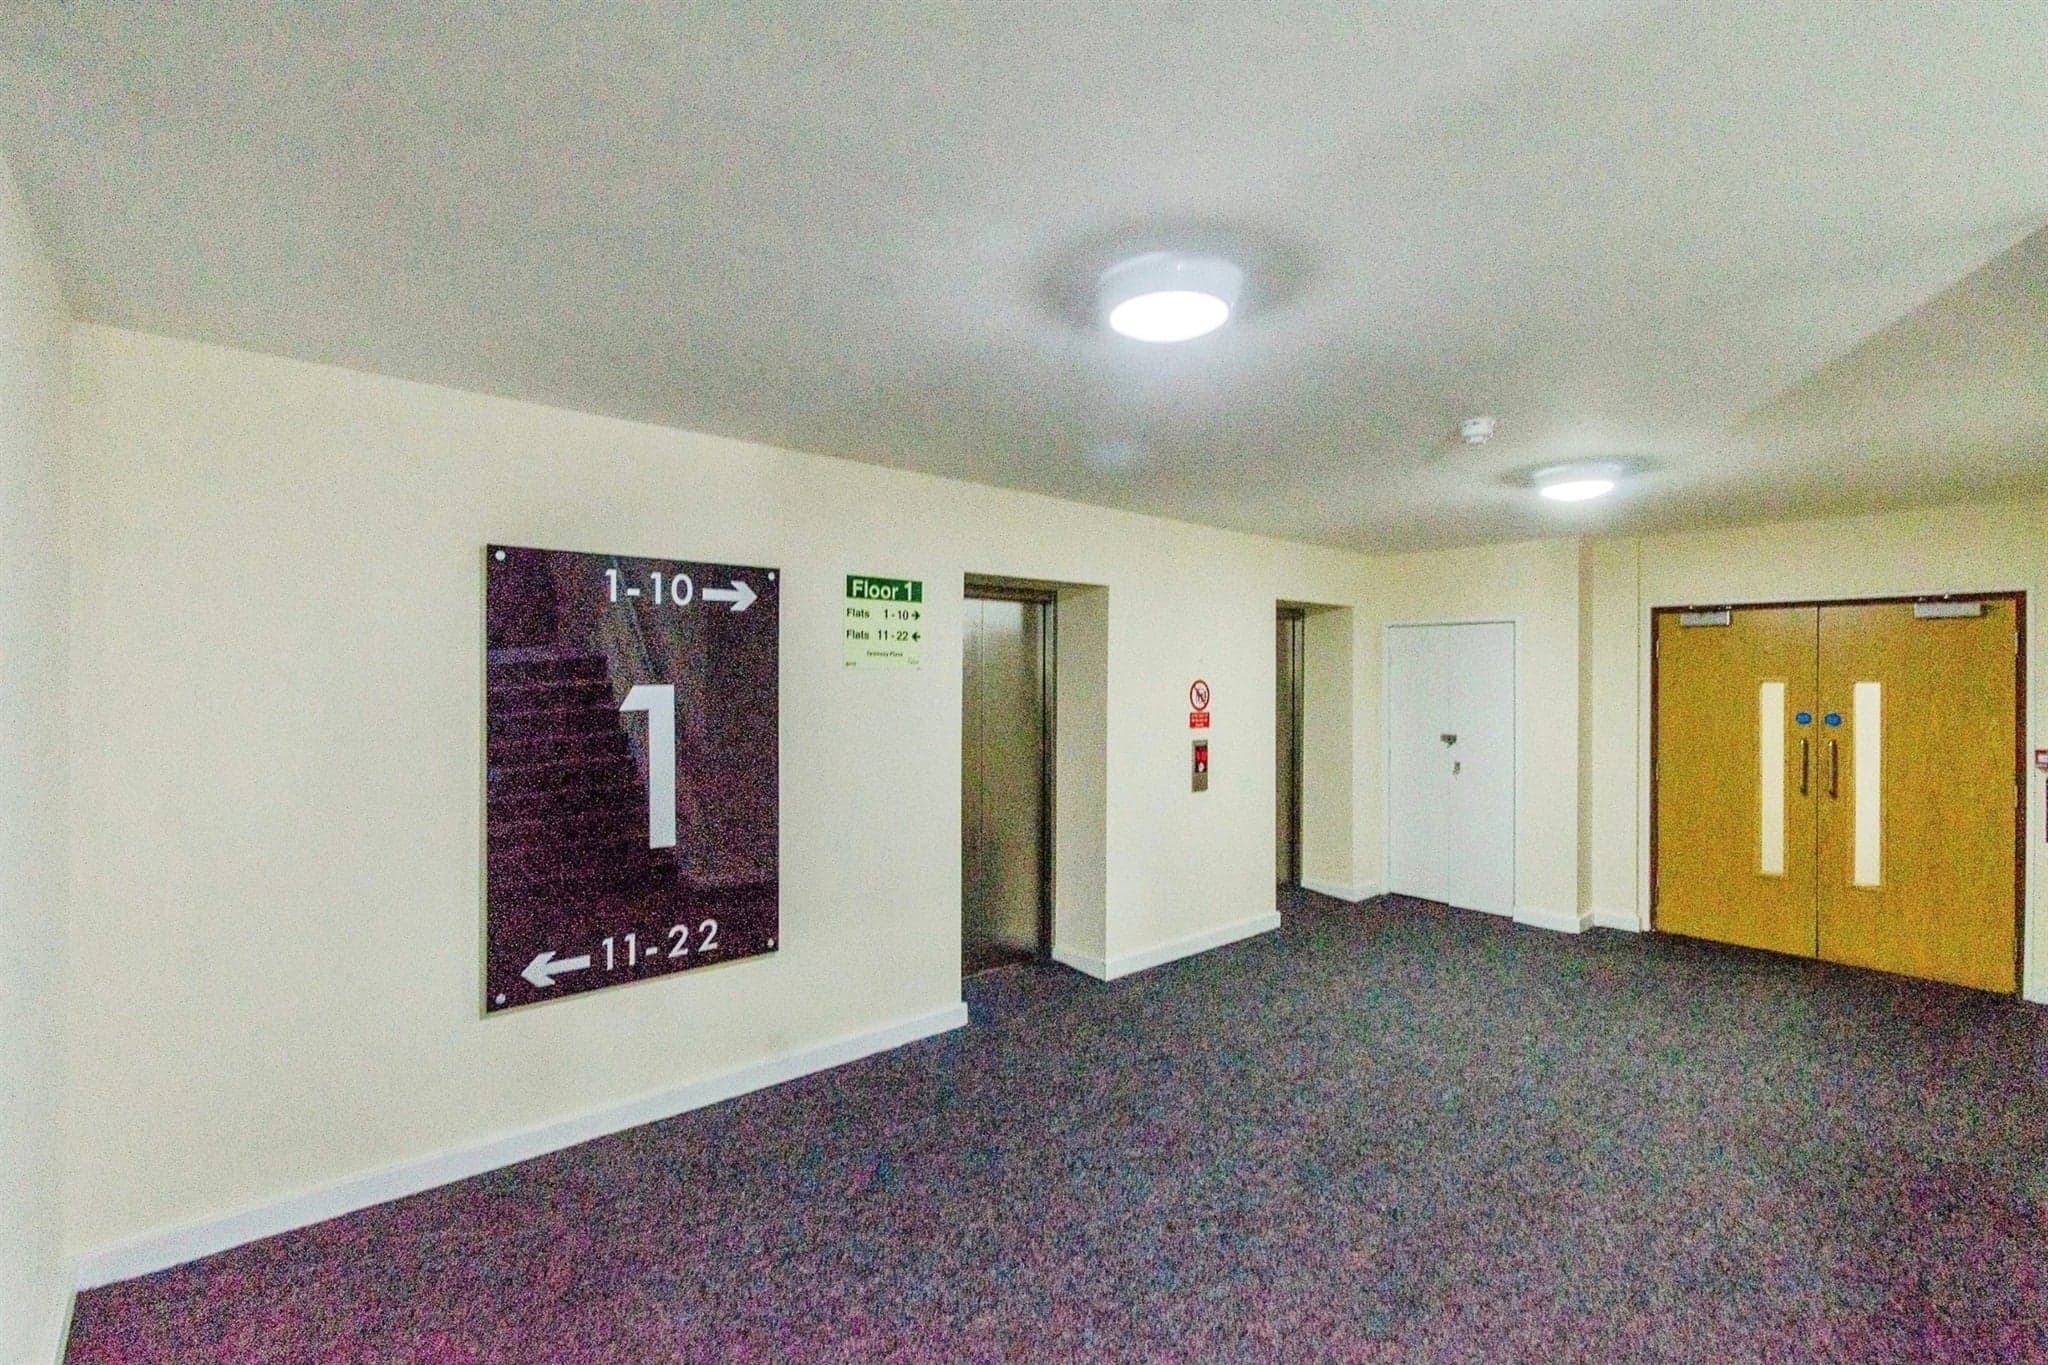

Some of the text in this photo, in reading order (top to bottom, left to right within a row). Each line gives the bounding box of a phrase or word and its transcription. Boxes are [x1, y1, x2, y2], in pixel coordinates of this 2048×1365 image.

[852, 579, 912, 602] Floor 1
[846, 608, 870, 619] Flats
[846, 629, 869, 641] Flats
[619, 684, 676, 849] 1
